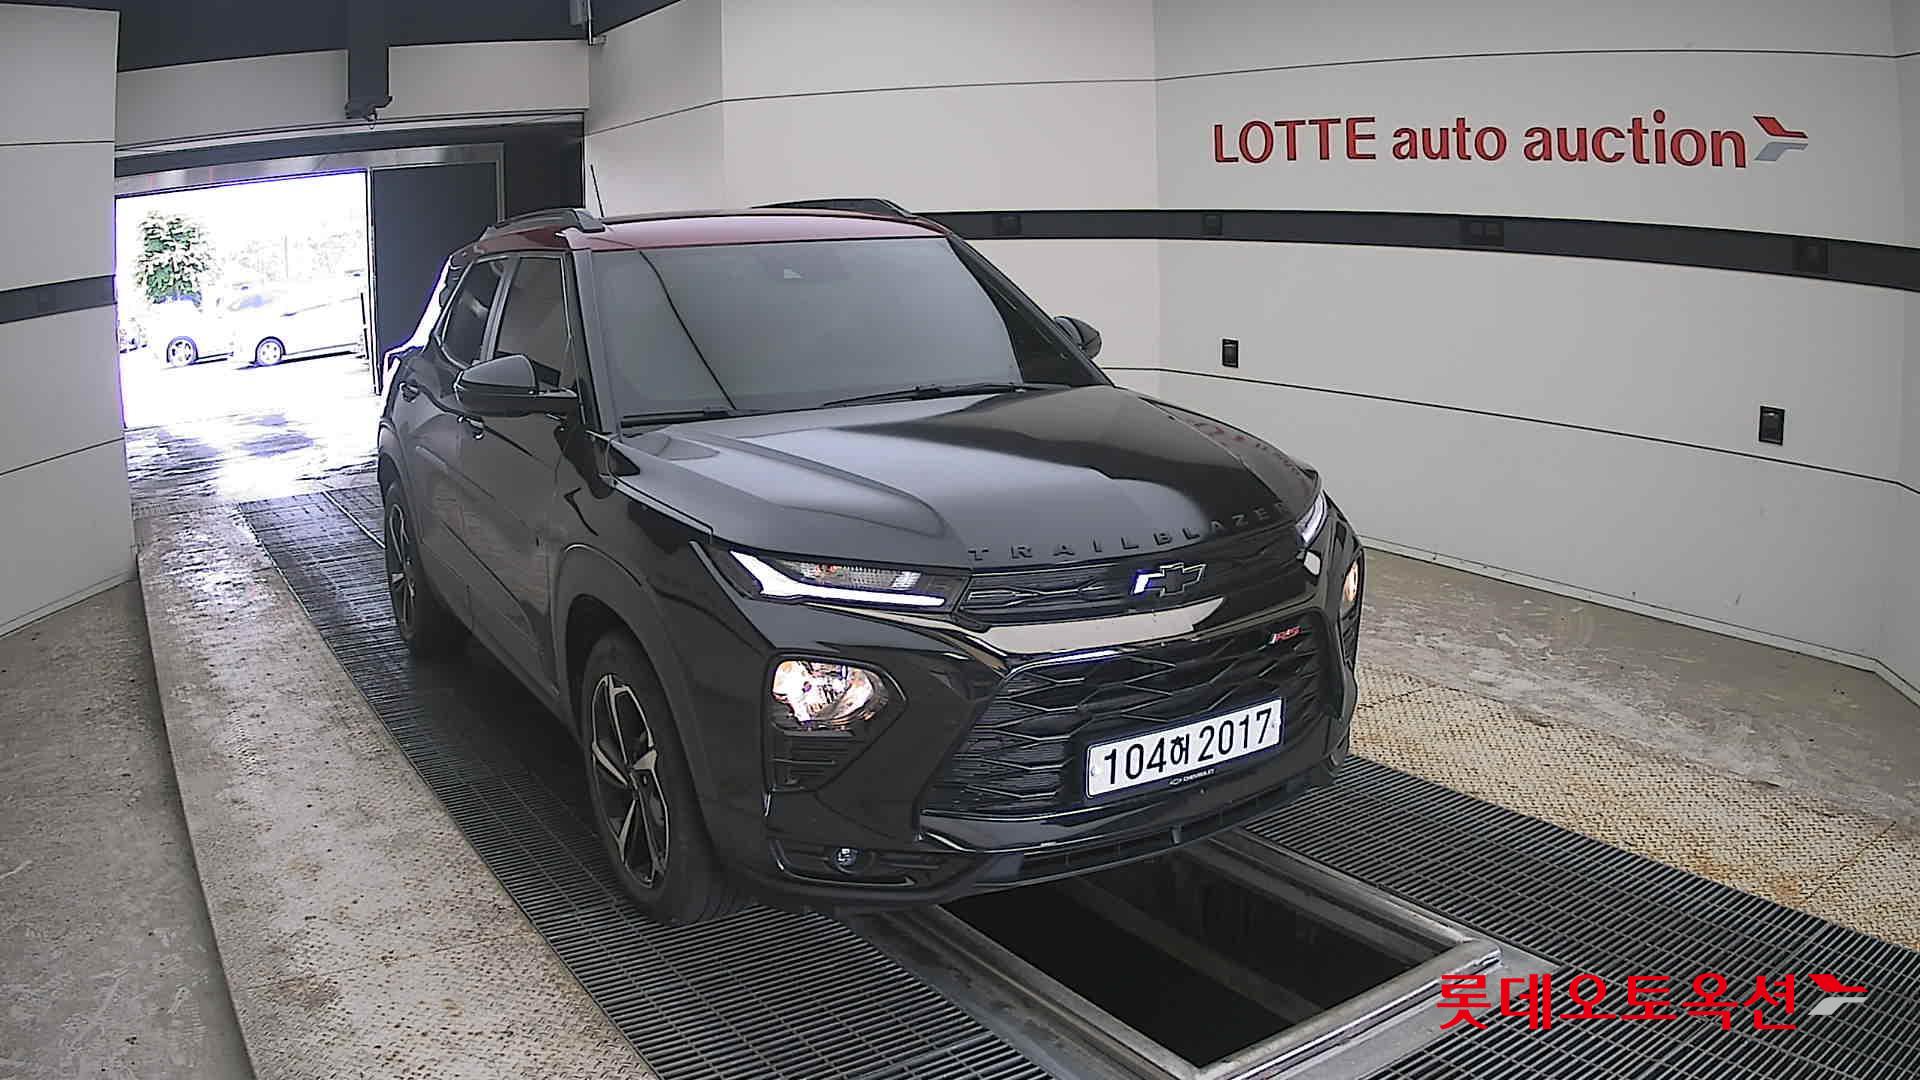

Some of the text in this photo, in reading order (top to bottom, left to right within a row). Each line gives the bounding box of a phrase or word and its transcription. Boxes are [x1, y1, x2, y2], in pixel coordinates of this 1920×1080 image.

[1213, 109, 1747, 168] LOTTE auto auction
[1197, 708, 1273, 762] 2017
